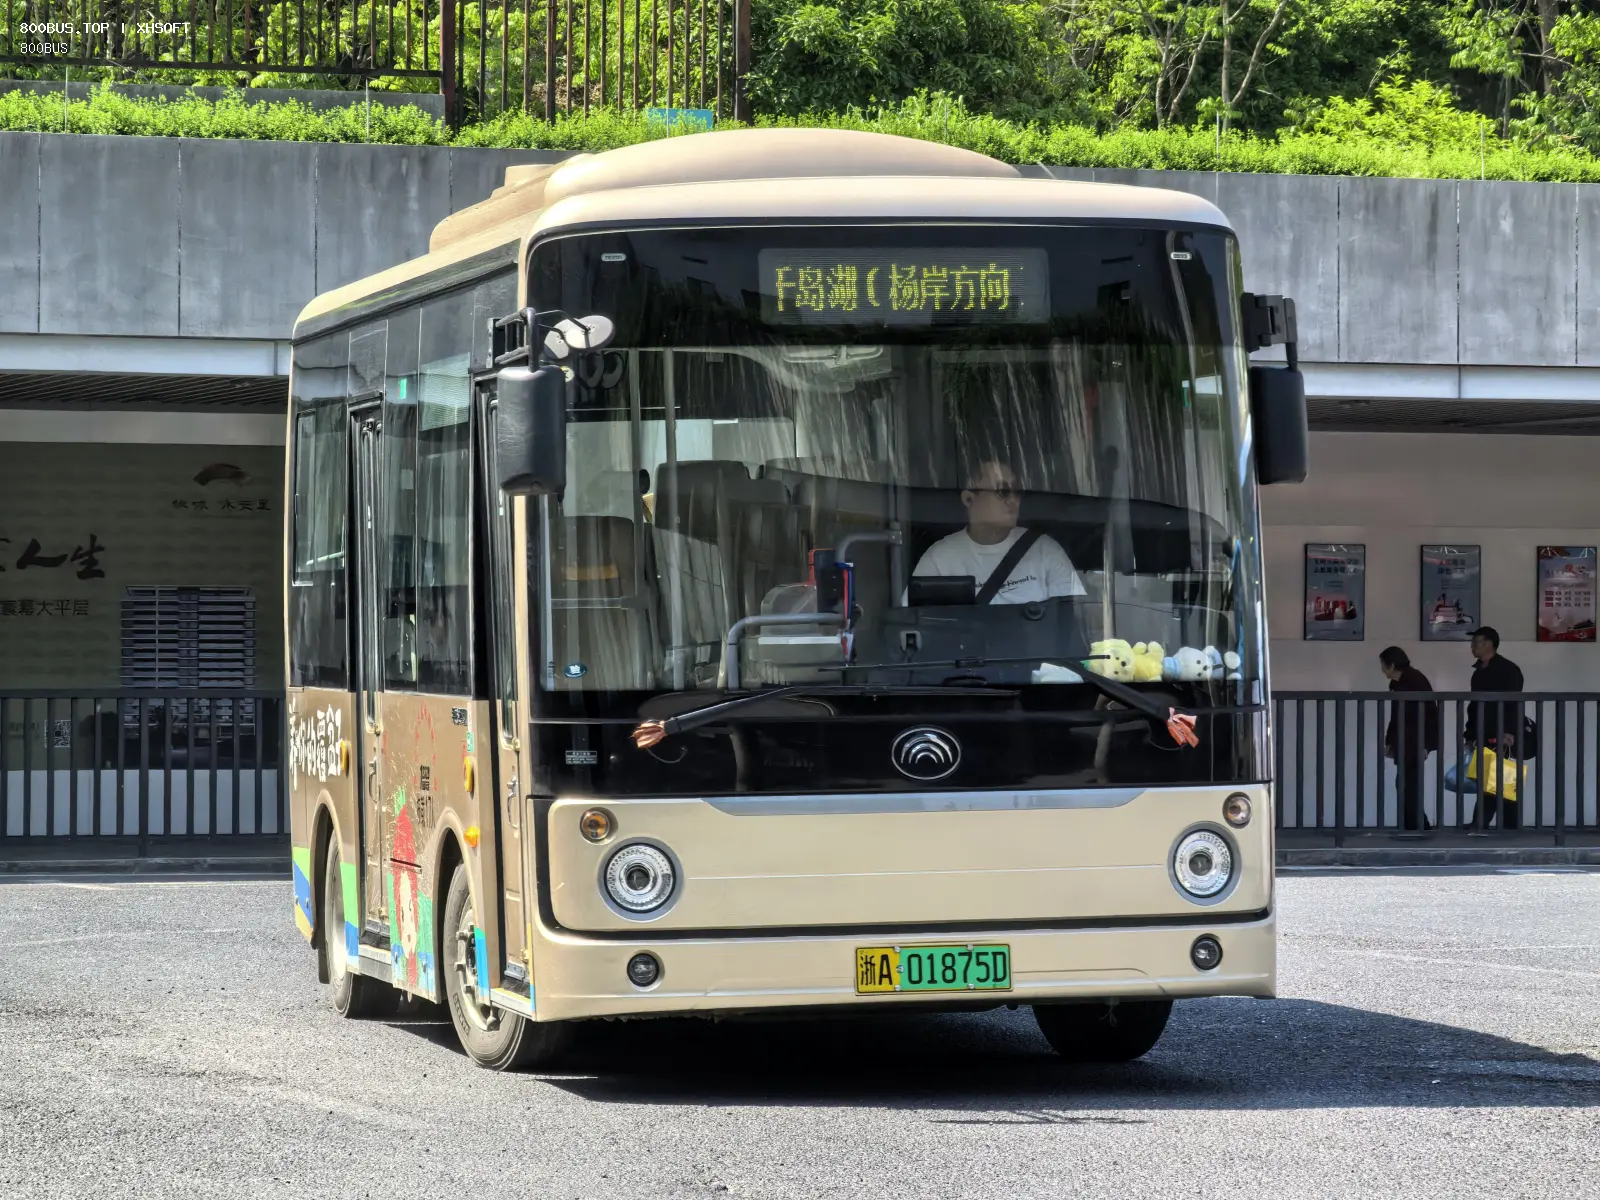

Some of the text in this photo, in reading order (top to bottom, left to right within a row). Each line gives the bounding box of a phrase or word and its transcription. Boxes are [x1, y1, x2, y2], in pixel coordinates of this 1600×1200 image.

[0, 533, 106, 580] 人生
[860, 951, 1008, 986] 浙A 01875D
